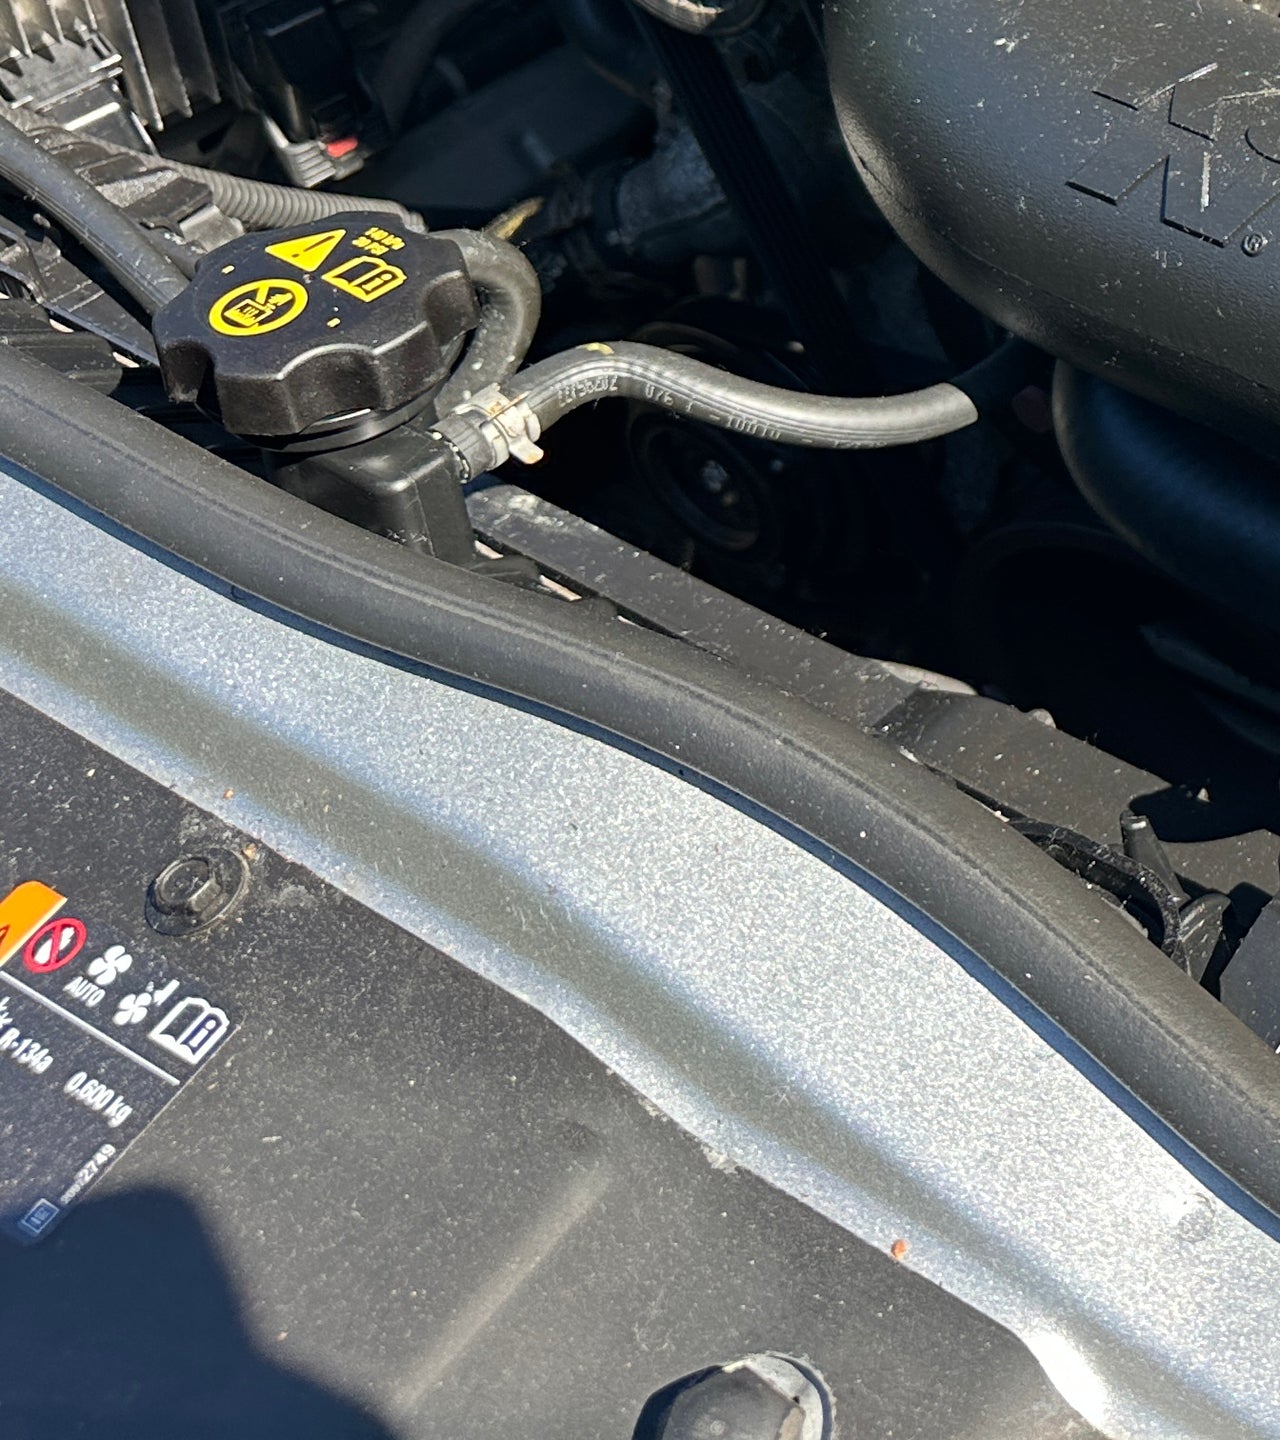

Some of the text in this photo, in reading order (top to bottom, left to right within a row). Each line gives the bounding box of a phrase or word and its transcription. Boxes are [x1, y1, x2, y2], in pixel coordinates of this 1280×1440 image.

[62, 976, 106, 1008] AUTO
[63, 1071, 133, 1128] 0.600 kg
